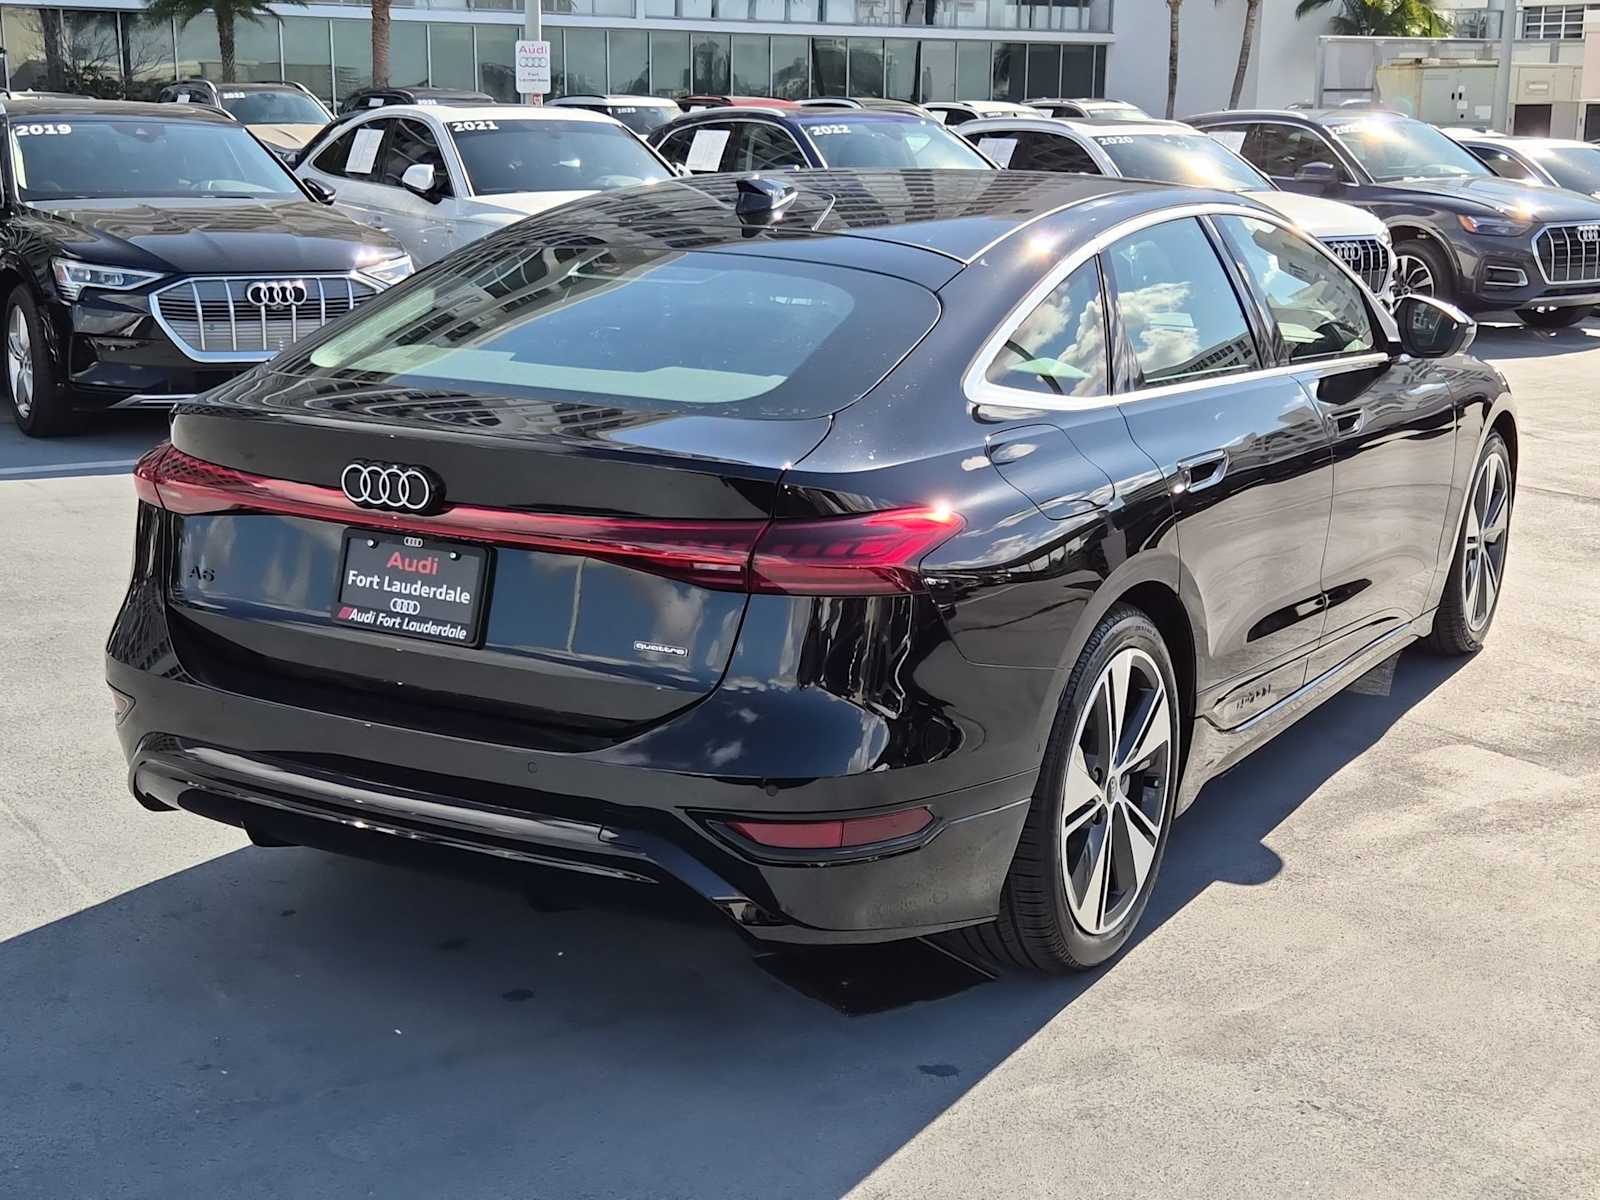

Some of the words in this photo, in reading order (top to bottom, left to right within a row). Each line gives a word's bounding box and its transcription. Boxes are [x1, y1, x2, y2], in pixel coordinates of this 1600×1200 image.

[519, 46, 548, 54] Audi
[15, 124, 72, 136] 2019
[452, 121, 499, 132] 2021
[810, 124, 852, 136] 2022
[1097, 136, 1134, 145] 2020
[387, 552, 439, 575] Audi
[347, 570, 380, 589] Fort
[383, 576, 471, 604] Lauderdale
[348, 608, 376, 625] Audi
[377, 612, 401, 629] Fort
[403, 618, 467, 639] Lauderdale
[636, 643, 685, 655] quattro
